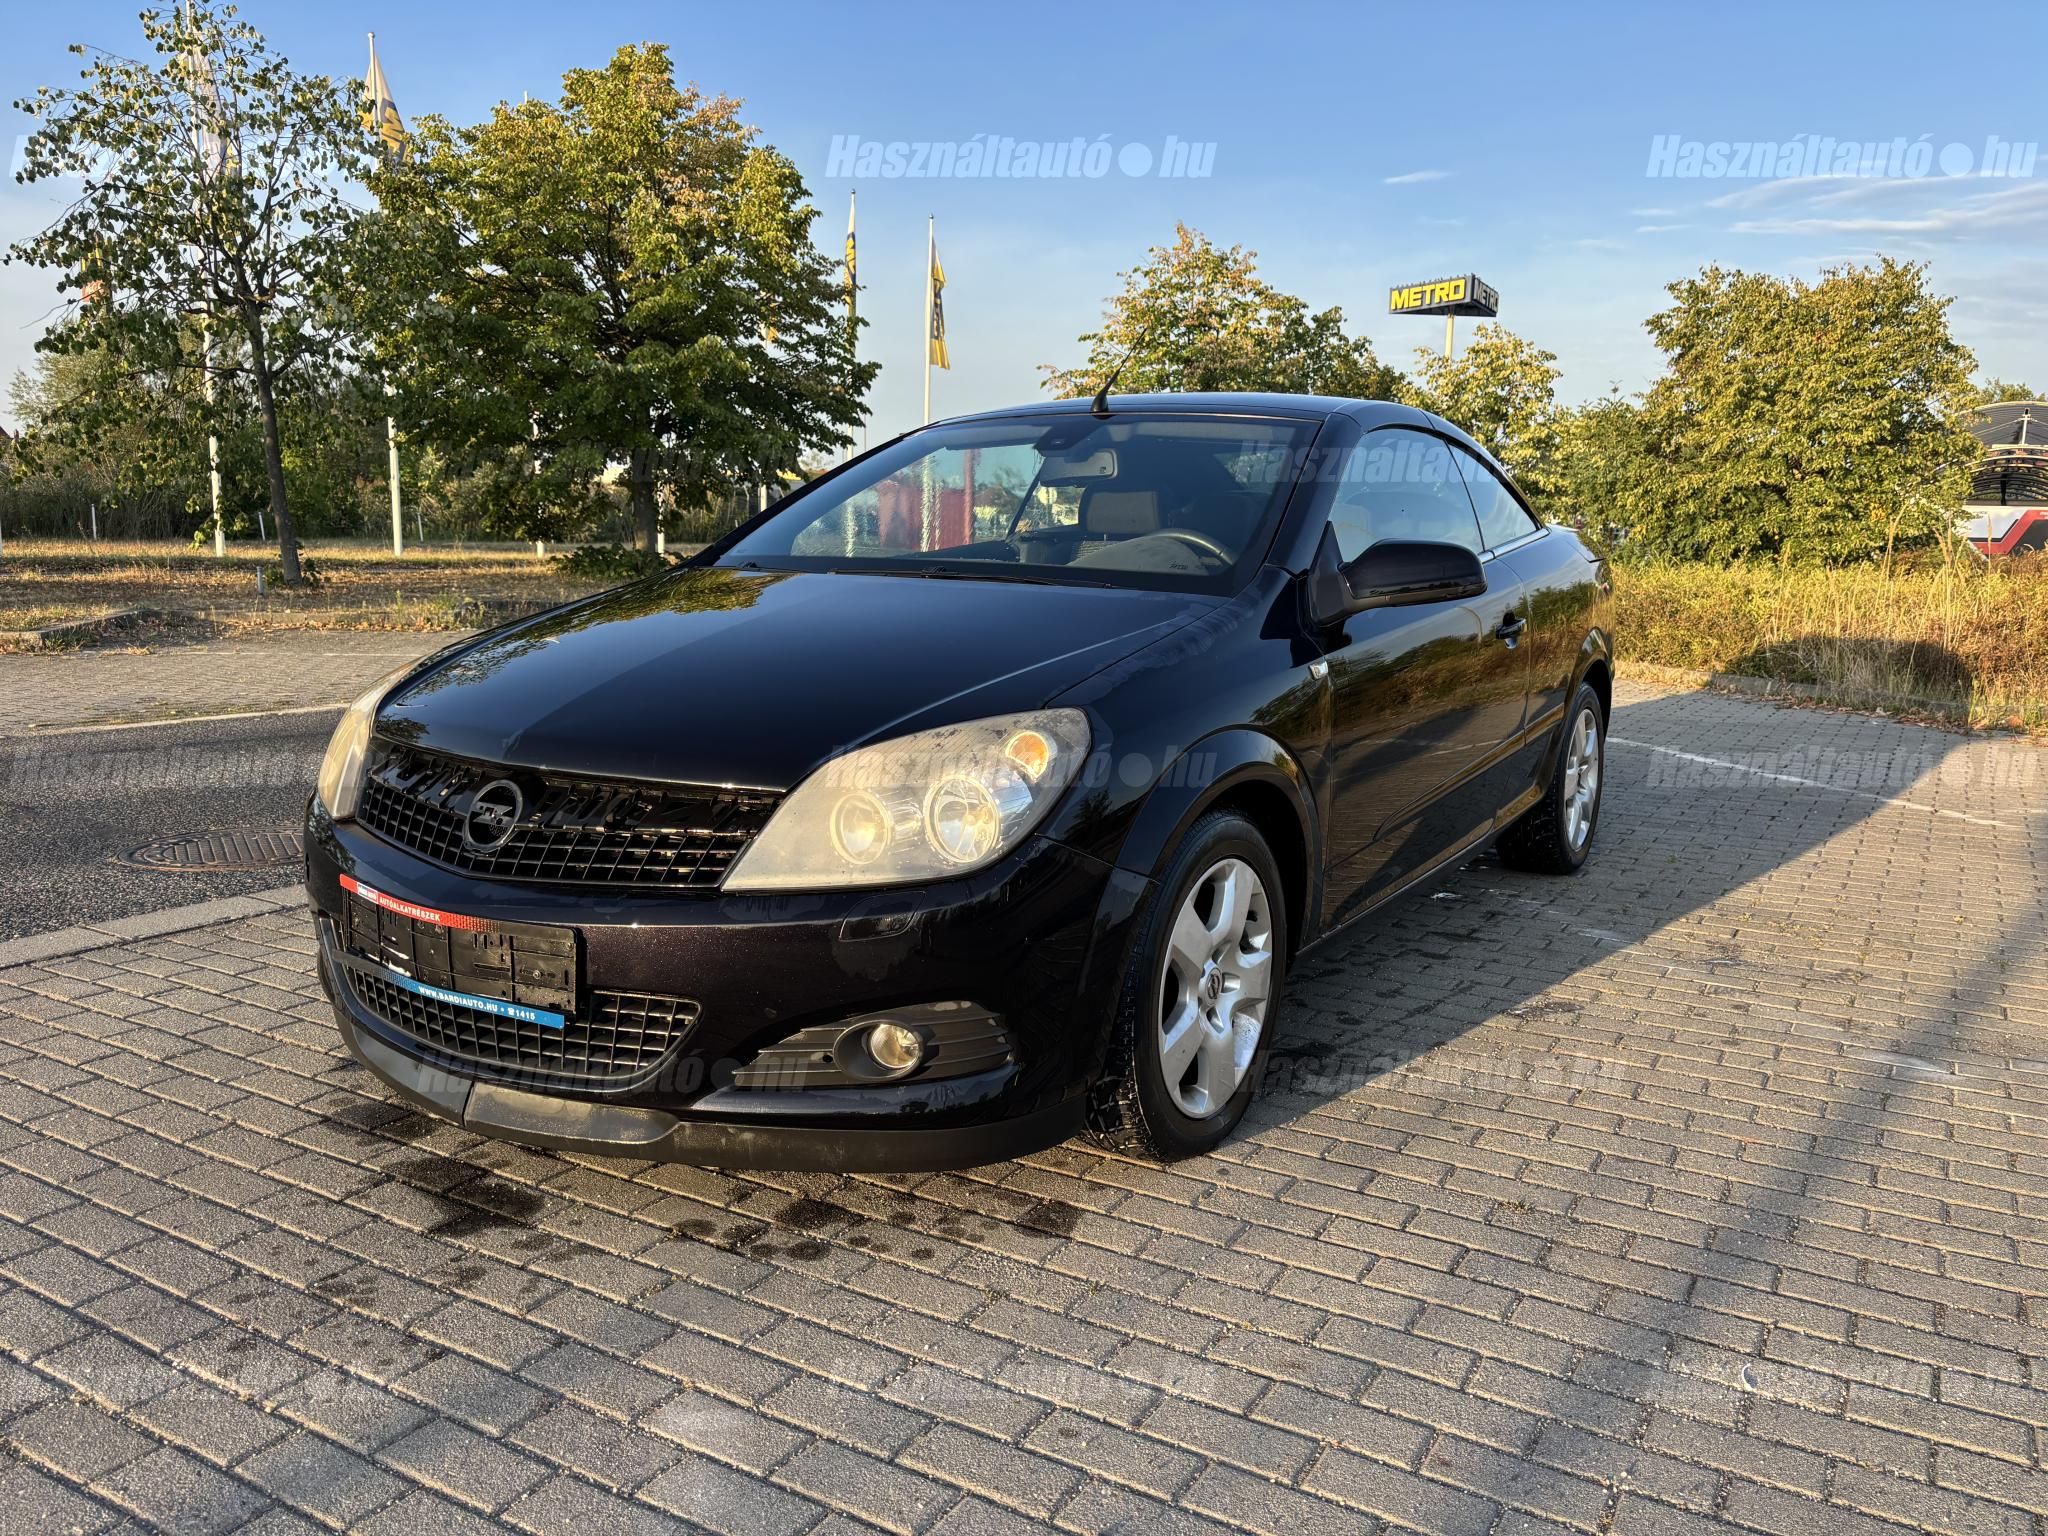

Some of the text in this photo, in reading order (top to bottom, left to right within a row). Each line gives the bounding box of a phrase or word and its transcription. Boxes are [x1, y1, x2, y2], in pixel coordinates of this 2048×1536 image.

[1391, 278, 1466, 311] METRO
[379, 896, 441, 922] AUTÓALKATRÉSZEK
[418, 985, 498, 1013] WWW.BARDIAUTO.HU
